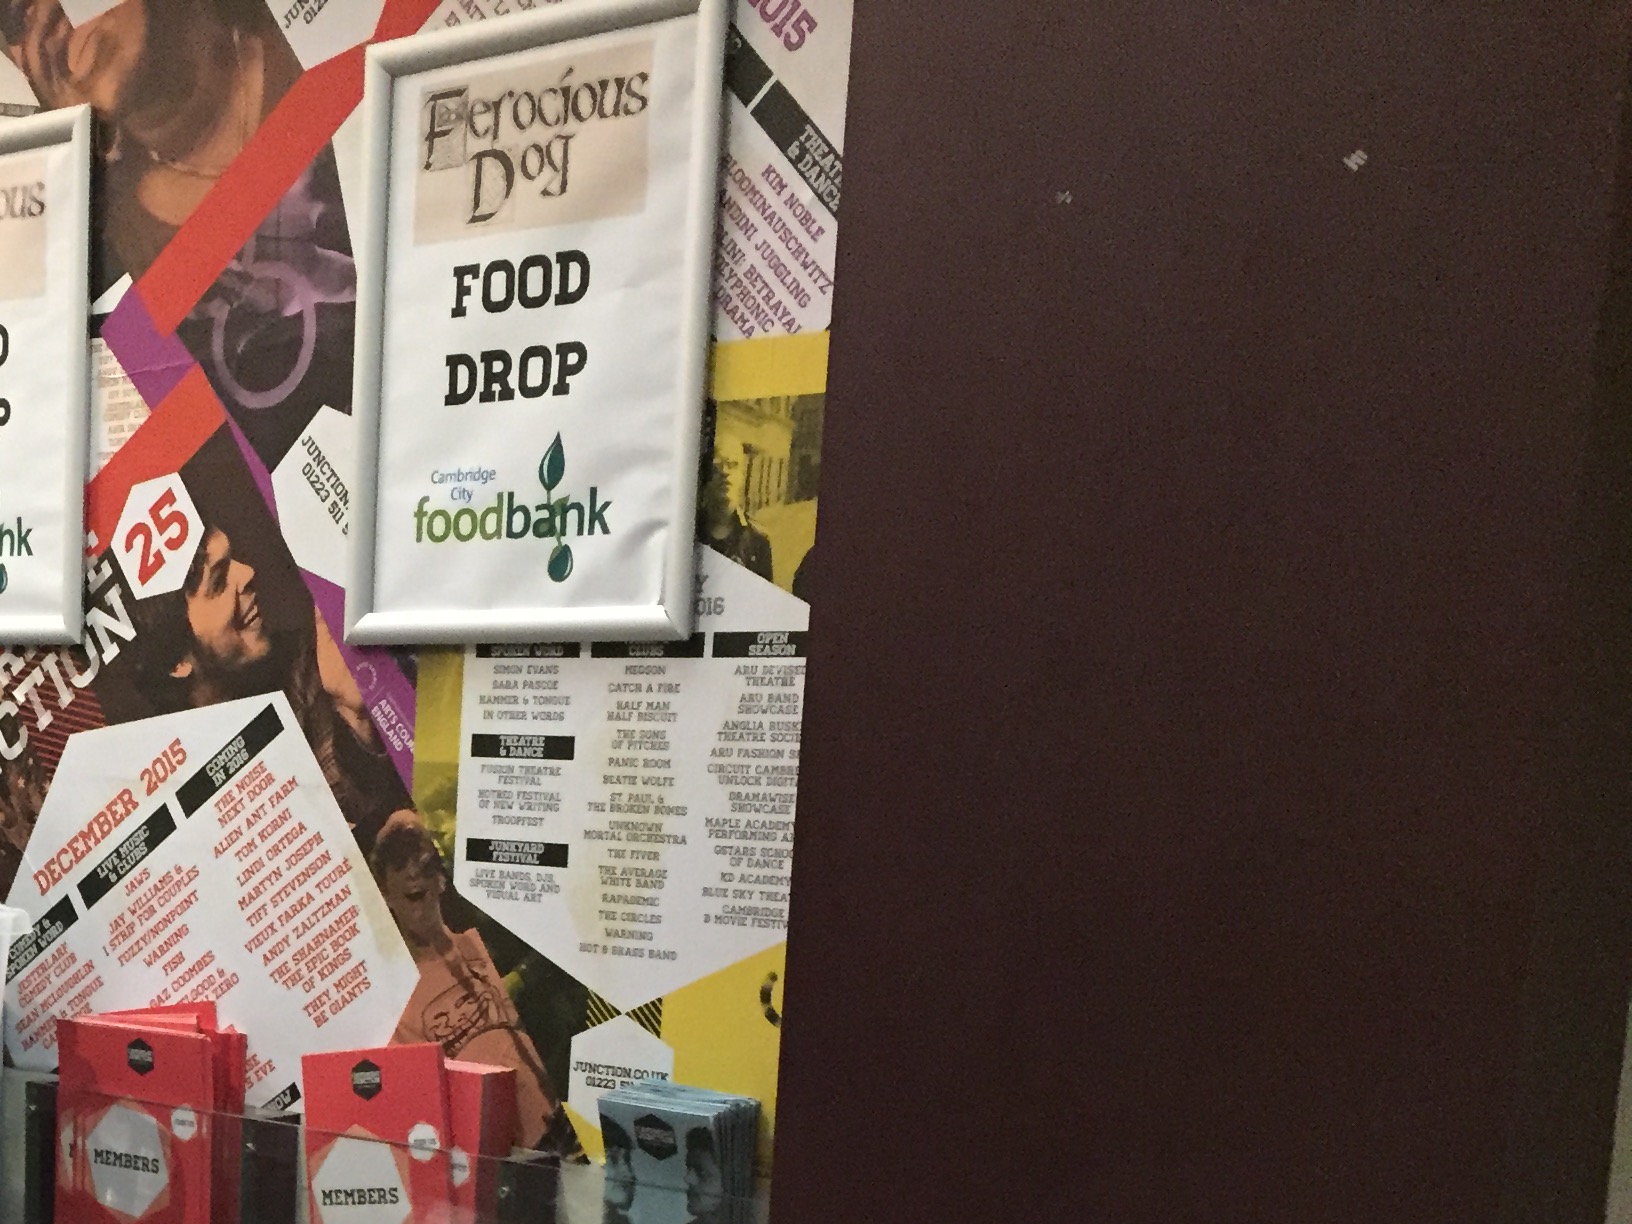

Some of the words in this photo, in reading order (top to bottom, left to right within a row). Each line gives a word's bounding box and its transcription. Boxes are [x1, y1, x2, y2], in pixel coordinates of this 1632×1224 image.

[423, 68, 649, 173] Ferocious
[467, 131, 574, 225] Dog
[761, 163, 789, 197] KIM
[783, 192, 826, 244] NOBLE
[450, 249, 591, 319] FOOD
[754, 237, 812, 309] JUGGLING
[444, 341, 588, 406] DROP
[301, 462, 330, 503] 01223
[430, 467, 497, 486] Cambridge
[450, 486, 473, 503] City
[123, 486, 190, 587] 25
[413, 486, 612, 544] foodbank
[748, 644, 797, 656] SEASON
[757, 632, 790, 644] OPEN
[379, 699, 396, 721] ARTS
[646, 700, 671, 711] MAN
[371, 708, 404, 752] ENGLAND
[499, 735, 546, 747] THEATRE
[205, 735, 247, 777] COMING
[212, 769, 226, 788] IN
[226, 748, 249, 774] 2016
[214, 789, 237, 812] THE
[235, 760, 268, 795] NOISE
[217, 797, 246, 828] NEXT
[246, 772, 276, 803] DOOR
[32, 788, 139, 896] DECEMBER
[139, 737, 187, 797] 2015
[213, 826, 244, 859] ALIEN
[245, 803, 268, 831] ANT
[268, 775, 300, 809] FARM
[234, 838, 259, 862] TOM
[257, 807, 293, 843] KORNI
[96, 854, 121, 879] LIVE
[117, 825, 150, 857] MUSIC
[107, 870, 118, 883] &
[116, 843, 148, 873] CLUBS
[236, 857, 266, 887] LINDI
[265, 821, 307, 861] ORTEGA
[237, 866, 284, 911] MARTYN
[284, 831, 325, 871] JOSEPH
[598, 865, 617, 876] THE
[620, 866, 668, 879] AVERAGE
[108, 912, 128, 936] JAY
[127, 872, 176, 916] WILLIAMS
[173, 864, 184, 875] &
[124, 867, 151, 897] JAWS
[245, 903, 269, 928] TIFF
[269, 849, 332, 908] STEVENSON
[600, 876, 632, 888] WHITE
[635, 877, 665, 890] BAND
[109, 922, 137, 952] STRIP
[136, 905, 157, 927] FOR
[156, 865, 200, 908] COUPLES
[244, 922, 278, 954] VIEUX
[277, 891, 315, 927] FARKA
[262, 934, 292, 967] ANDY
[291, 885, 352, 940] ZALTZMAN
[142, 923, 190, 968] WARNING
[282, 968, 305, 991] THE
[305, 952, 330, 974] EPIC
[329, 922, 361, 951] BOOK
[604, 928, 654, 942] WARNING
[53, 952, 78, 979] CLUB
[161, 951, 186, 977] FISH
[170, 950, 216, 993] COOMBES
[269, 961, 290, 984] THE
[301, 975, 317, 994] OF
[317, 947, 353, 982] KINGS
[303, 988, 332, 1017] THEY
[332, 959, 368, 994] MIGHT
[312, 1008, 330, 1028] BE
[328, 976, 372, 1016] GIANTS
[585, 1075, 616, 1090] 01223
[93, 1148, 160, 1175] MEMBERS
[321, 1187, 400, 1207] MEMBERS
